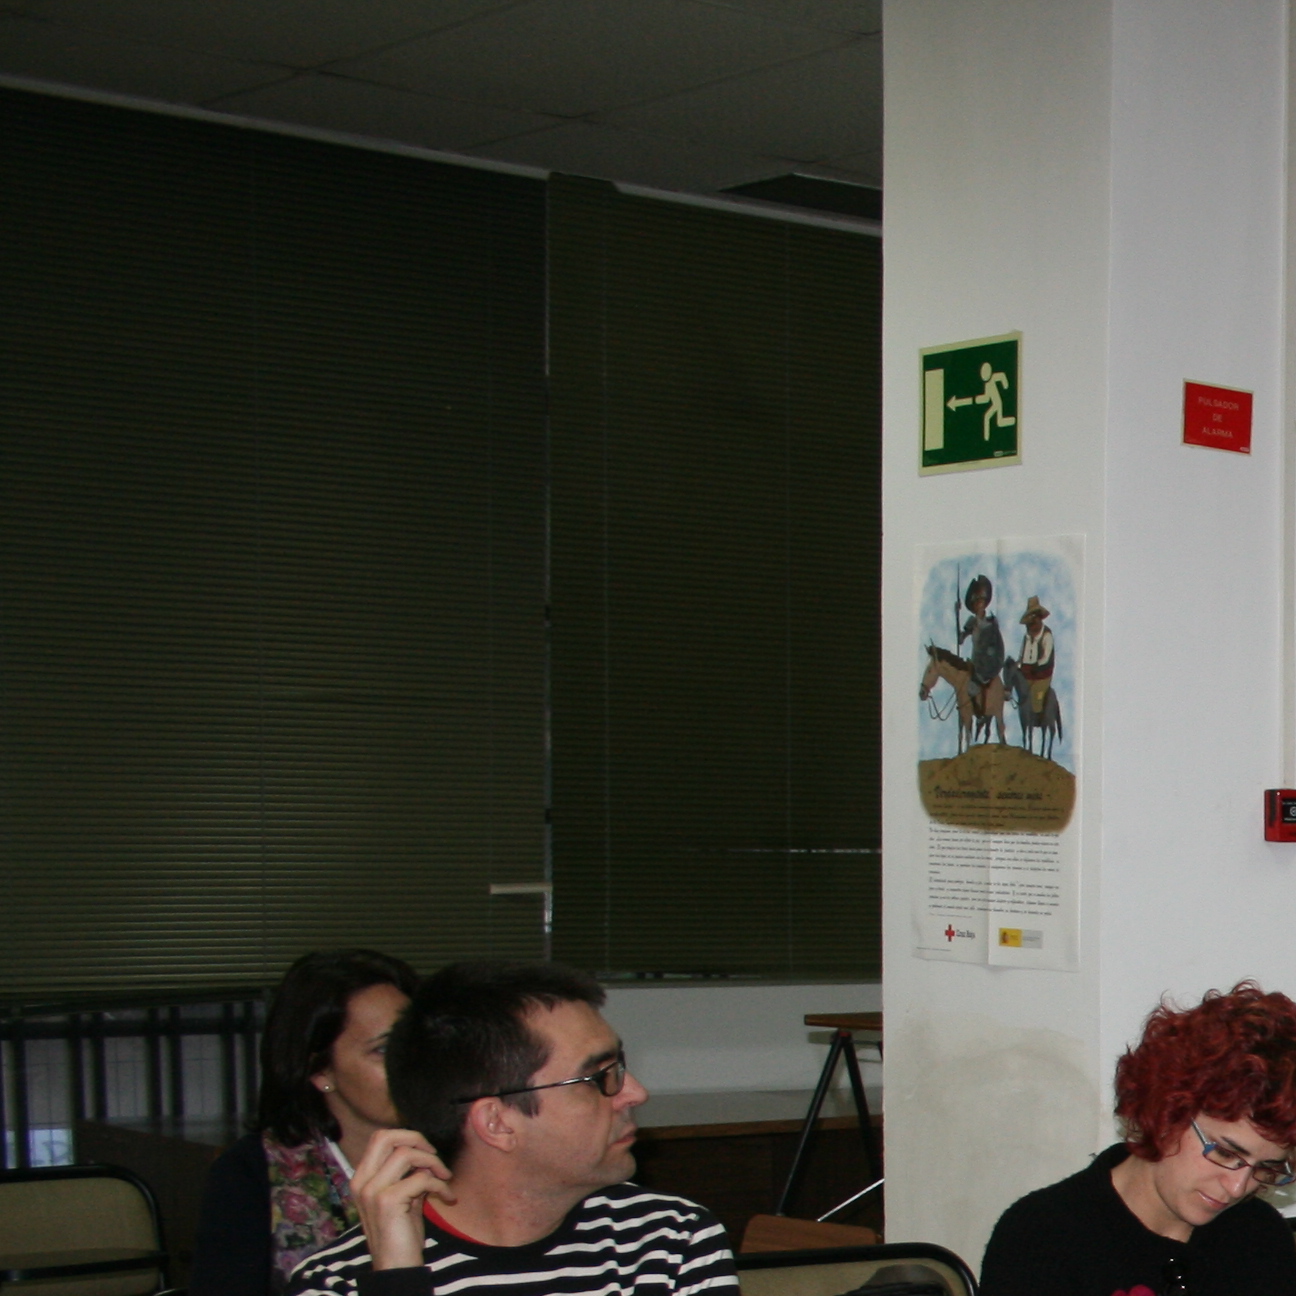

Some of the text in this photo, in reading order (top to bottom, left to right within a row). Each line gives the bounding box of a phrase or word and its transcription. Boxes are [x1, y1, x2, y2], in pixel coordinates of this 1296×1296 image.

[1198, 396, 1239, 410] PULSADOR
[1212, 413, 1222, 422] DE
[1202, 427, 1233, 438] ALARMA
